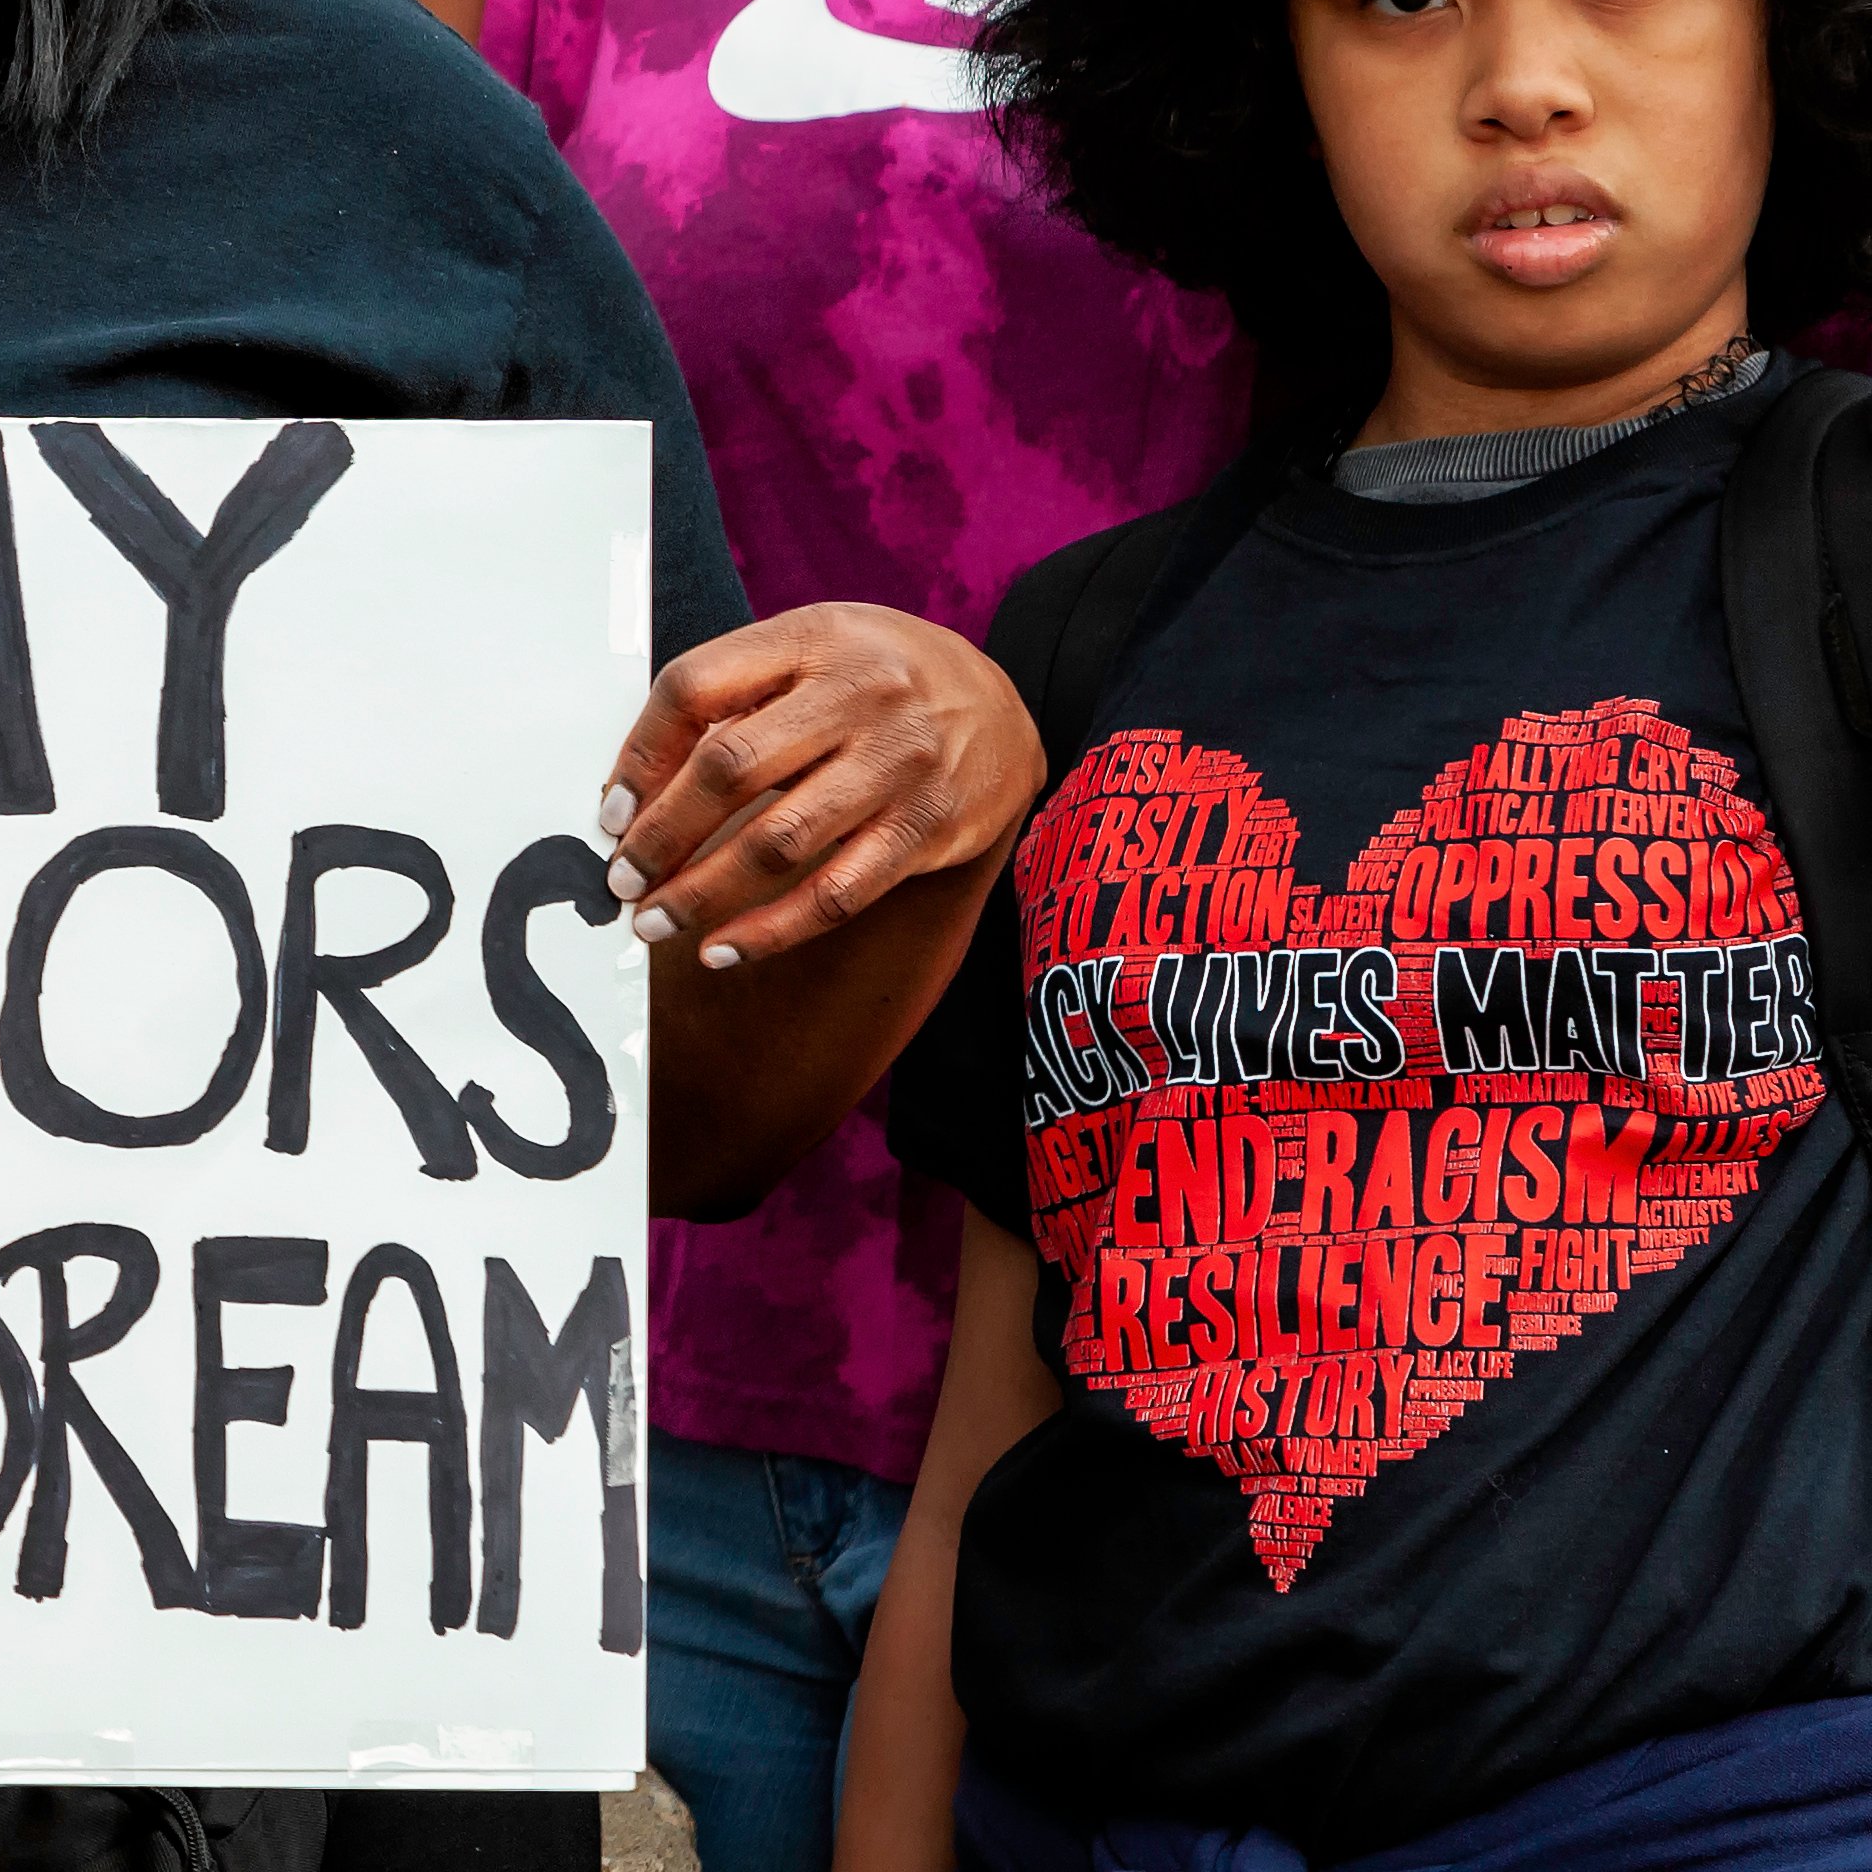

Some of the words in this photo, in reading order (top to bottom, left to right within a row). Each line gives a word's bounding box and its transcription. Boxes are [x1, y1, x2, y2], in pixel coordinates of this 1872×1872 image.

[1069, 742, 1204, 812] RACISM
[1466, 739, 1622, 793] RALLYING
[1628, 739, 1692, 792] CRY
[1418, 792, 1556, 843] POLITICAL
[1563, 787, 1766, 845] INTERVENTION
[1232, 830, 1302, 869] LGBT
[1346, 861, 1400, 892] WOC
[1392, 837, 1784, 941] OPPRESSION
[1051, 878, 1100, 966] TO
[1106, 867, 1295, 950] ACTION
[1289, 894, 1391, 932] SLAVERY
[1148, 946, 1406, 1085] LIVES
[1433, 932, 1824, 1081] MATTER
[1641, 980, 1680, 1004] WOC
[1641, 1006, 1680, 1033] POC
[1221, 1077, 1434, 1115] DE-HUMANIZATION
[1454, 1072, 1590, 1105] AFFIRMATION
[1603, 1075, 1743, 1118] RESTORATIVE
[1744, 1064, 1826, 1110] JUSTICE
[1651, 1109, 1792, 1164] ALLIES
[1115, 1114, 1276, 1249] END
[1299, 1103, 1658, 1235] RACISM
[1639, 1160, 1760, 1198] MOVEMENT
[1637, 1198, 1735, 1227] ACTIVISTS
[1639, 1227, 1711, 1249] DIVERSITY
[1519, 1228, 1636, 1291] FIGHT
[1100, 1227, 1506, 1374] RESILIENCE
[1431, 1272, 1465, 1299] POC
[1509, 1314, 1583, 1336] RESILIENCE
[1417, 1349, 1476, 1378] BLACK
[1477, 1351, 1516, 1379] LIFE
[1187, 1353, 1415, 1448] HISTORY
[1213, 1438, 1281, 1478] BLACK
[1282, 1436, 1379, 1478] WOMEN
